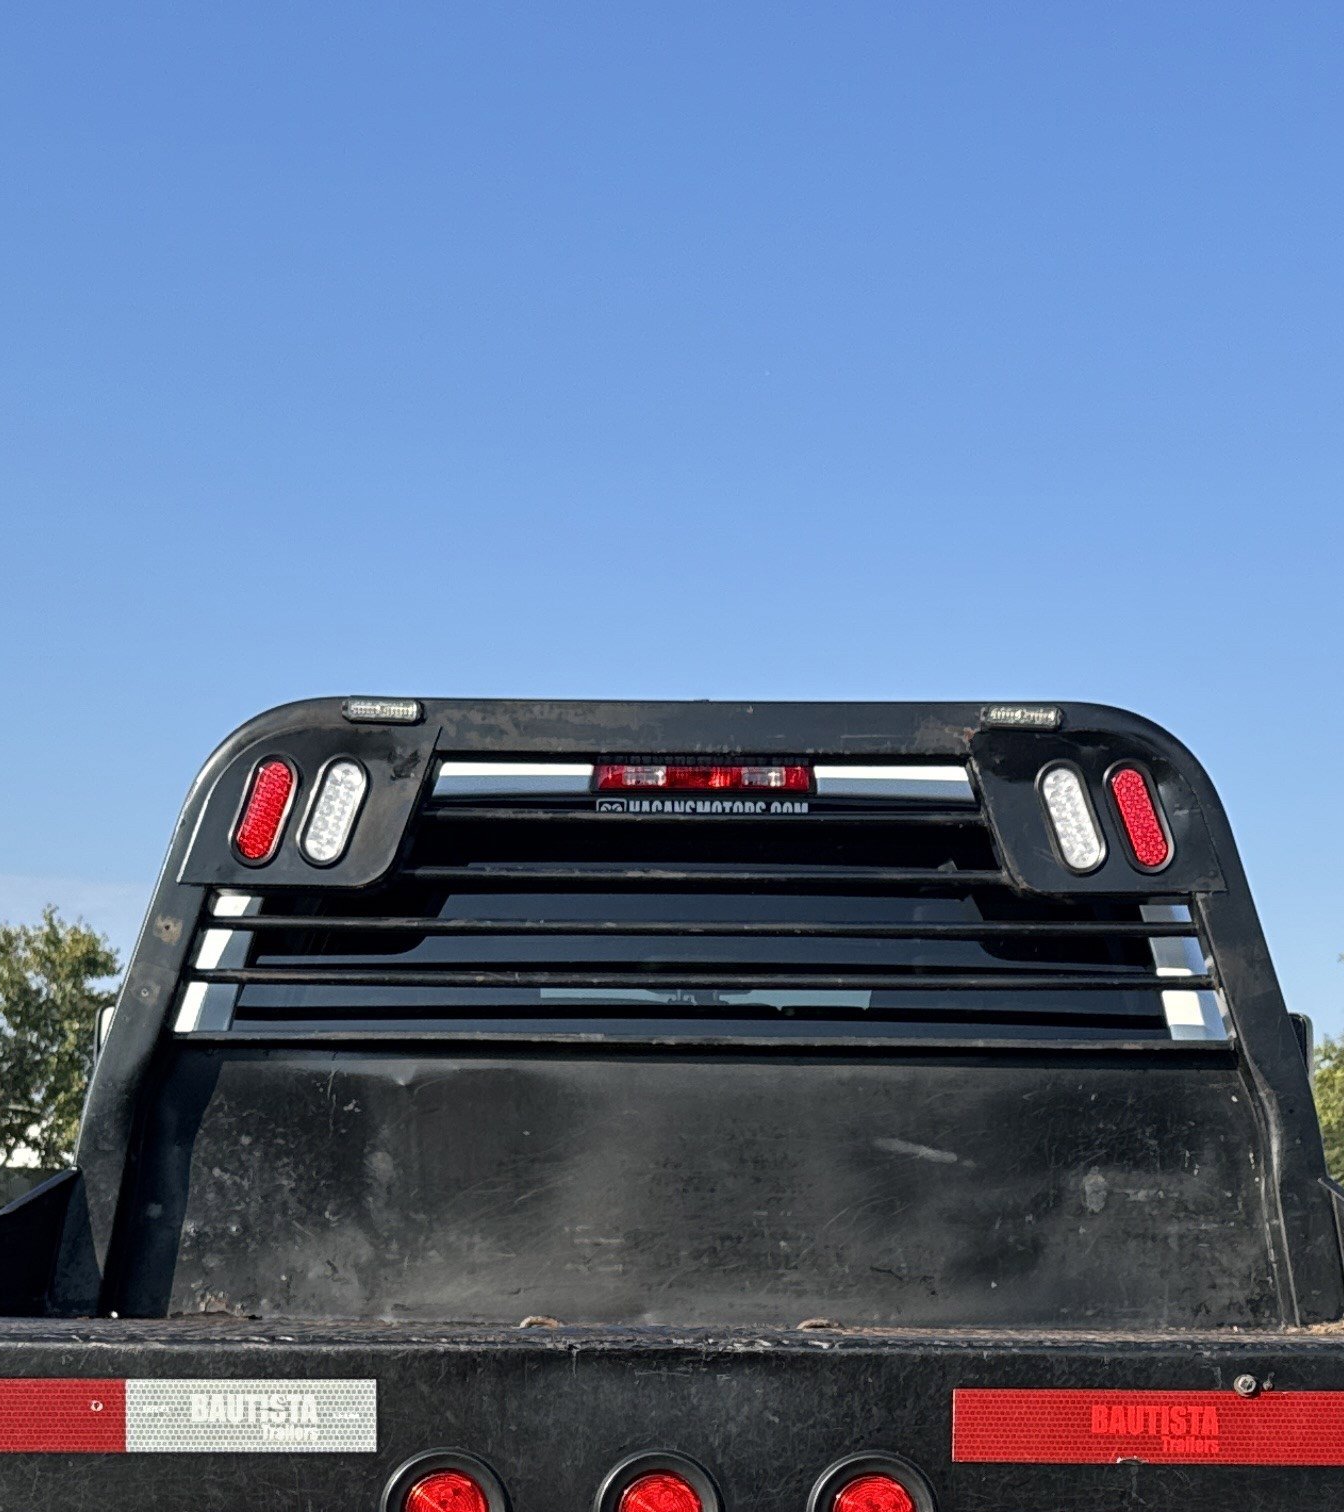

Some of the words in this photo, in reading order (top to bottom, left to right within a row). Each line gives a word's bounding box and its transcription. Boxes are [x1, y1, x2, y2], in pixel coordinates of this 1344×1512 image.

[191, 1393, 318, 1423] BAUTISTA
[1091, 1405, 1219, 1435] BAUTISTA
[1160, 1435, 1220, 1453] Trailers
